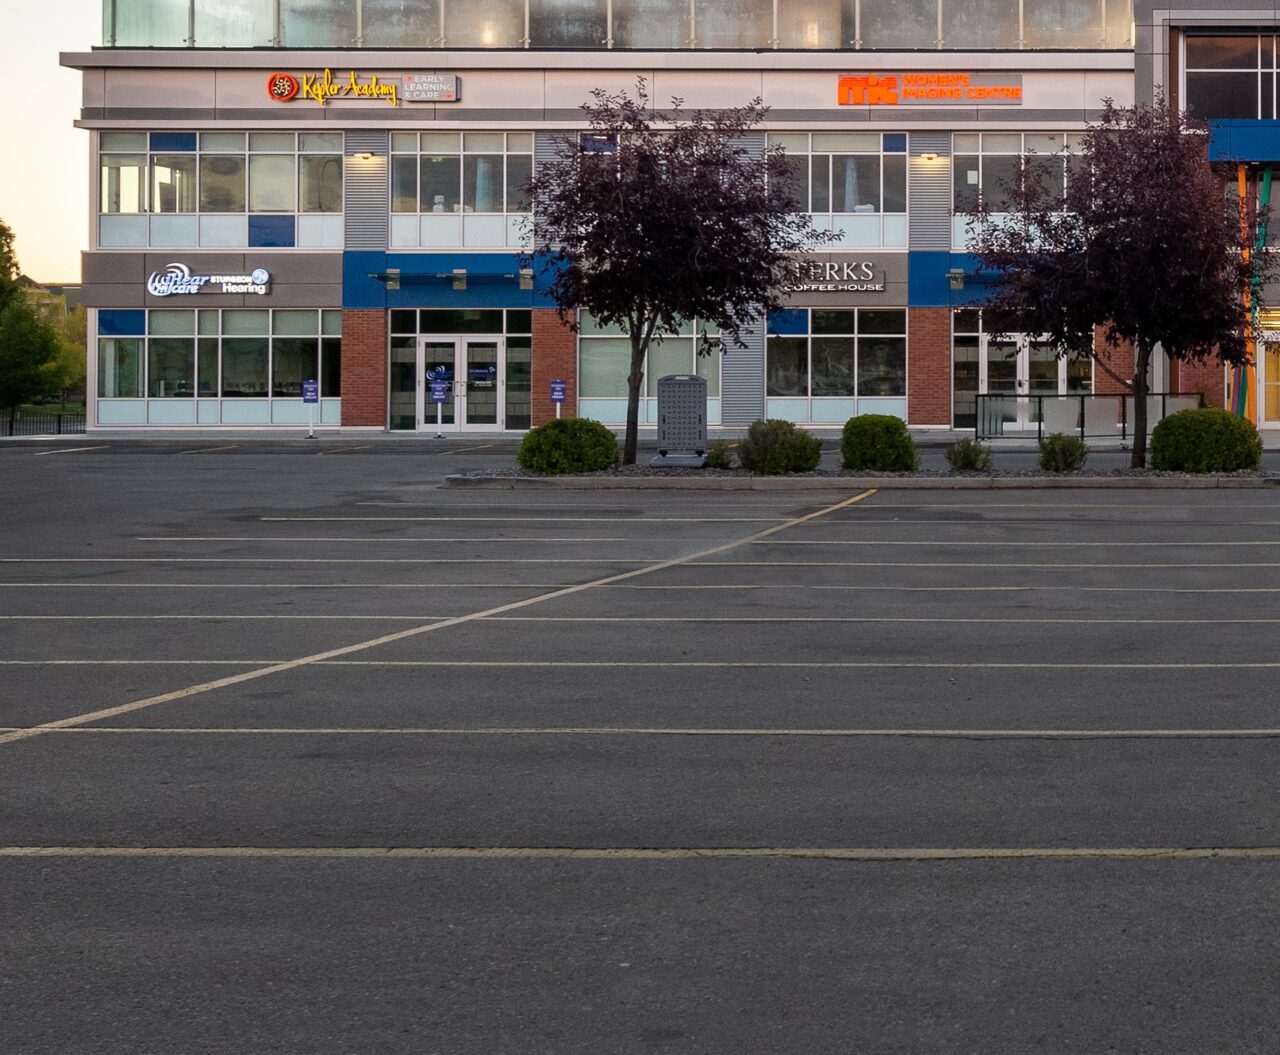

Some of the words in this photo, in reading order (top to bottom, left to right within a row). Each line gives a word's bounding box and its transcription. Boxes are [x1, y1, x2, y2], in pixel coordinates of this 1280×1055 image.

[902, 74, 970, 86] WOMEN'S
[302, 68, 342, 105] Kepler
[343, 70, 397, 106] Academy
[414, 91, 440, 99] CARE
[902, 87, 962, 100] IMAGING
[965, 87, 1022, 99] CENTRE
[222, 283, 266, 294] Hearing
